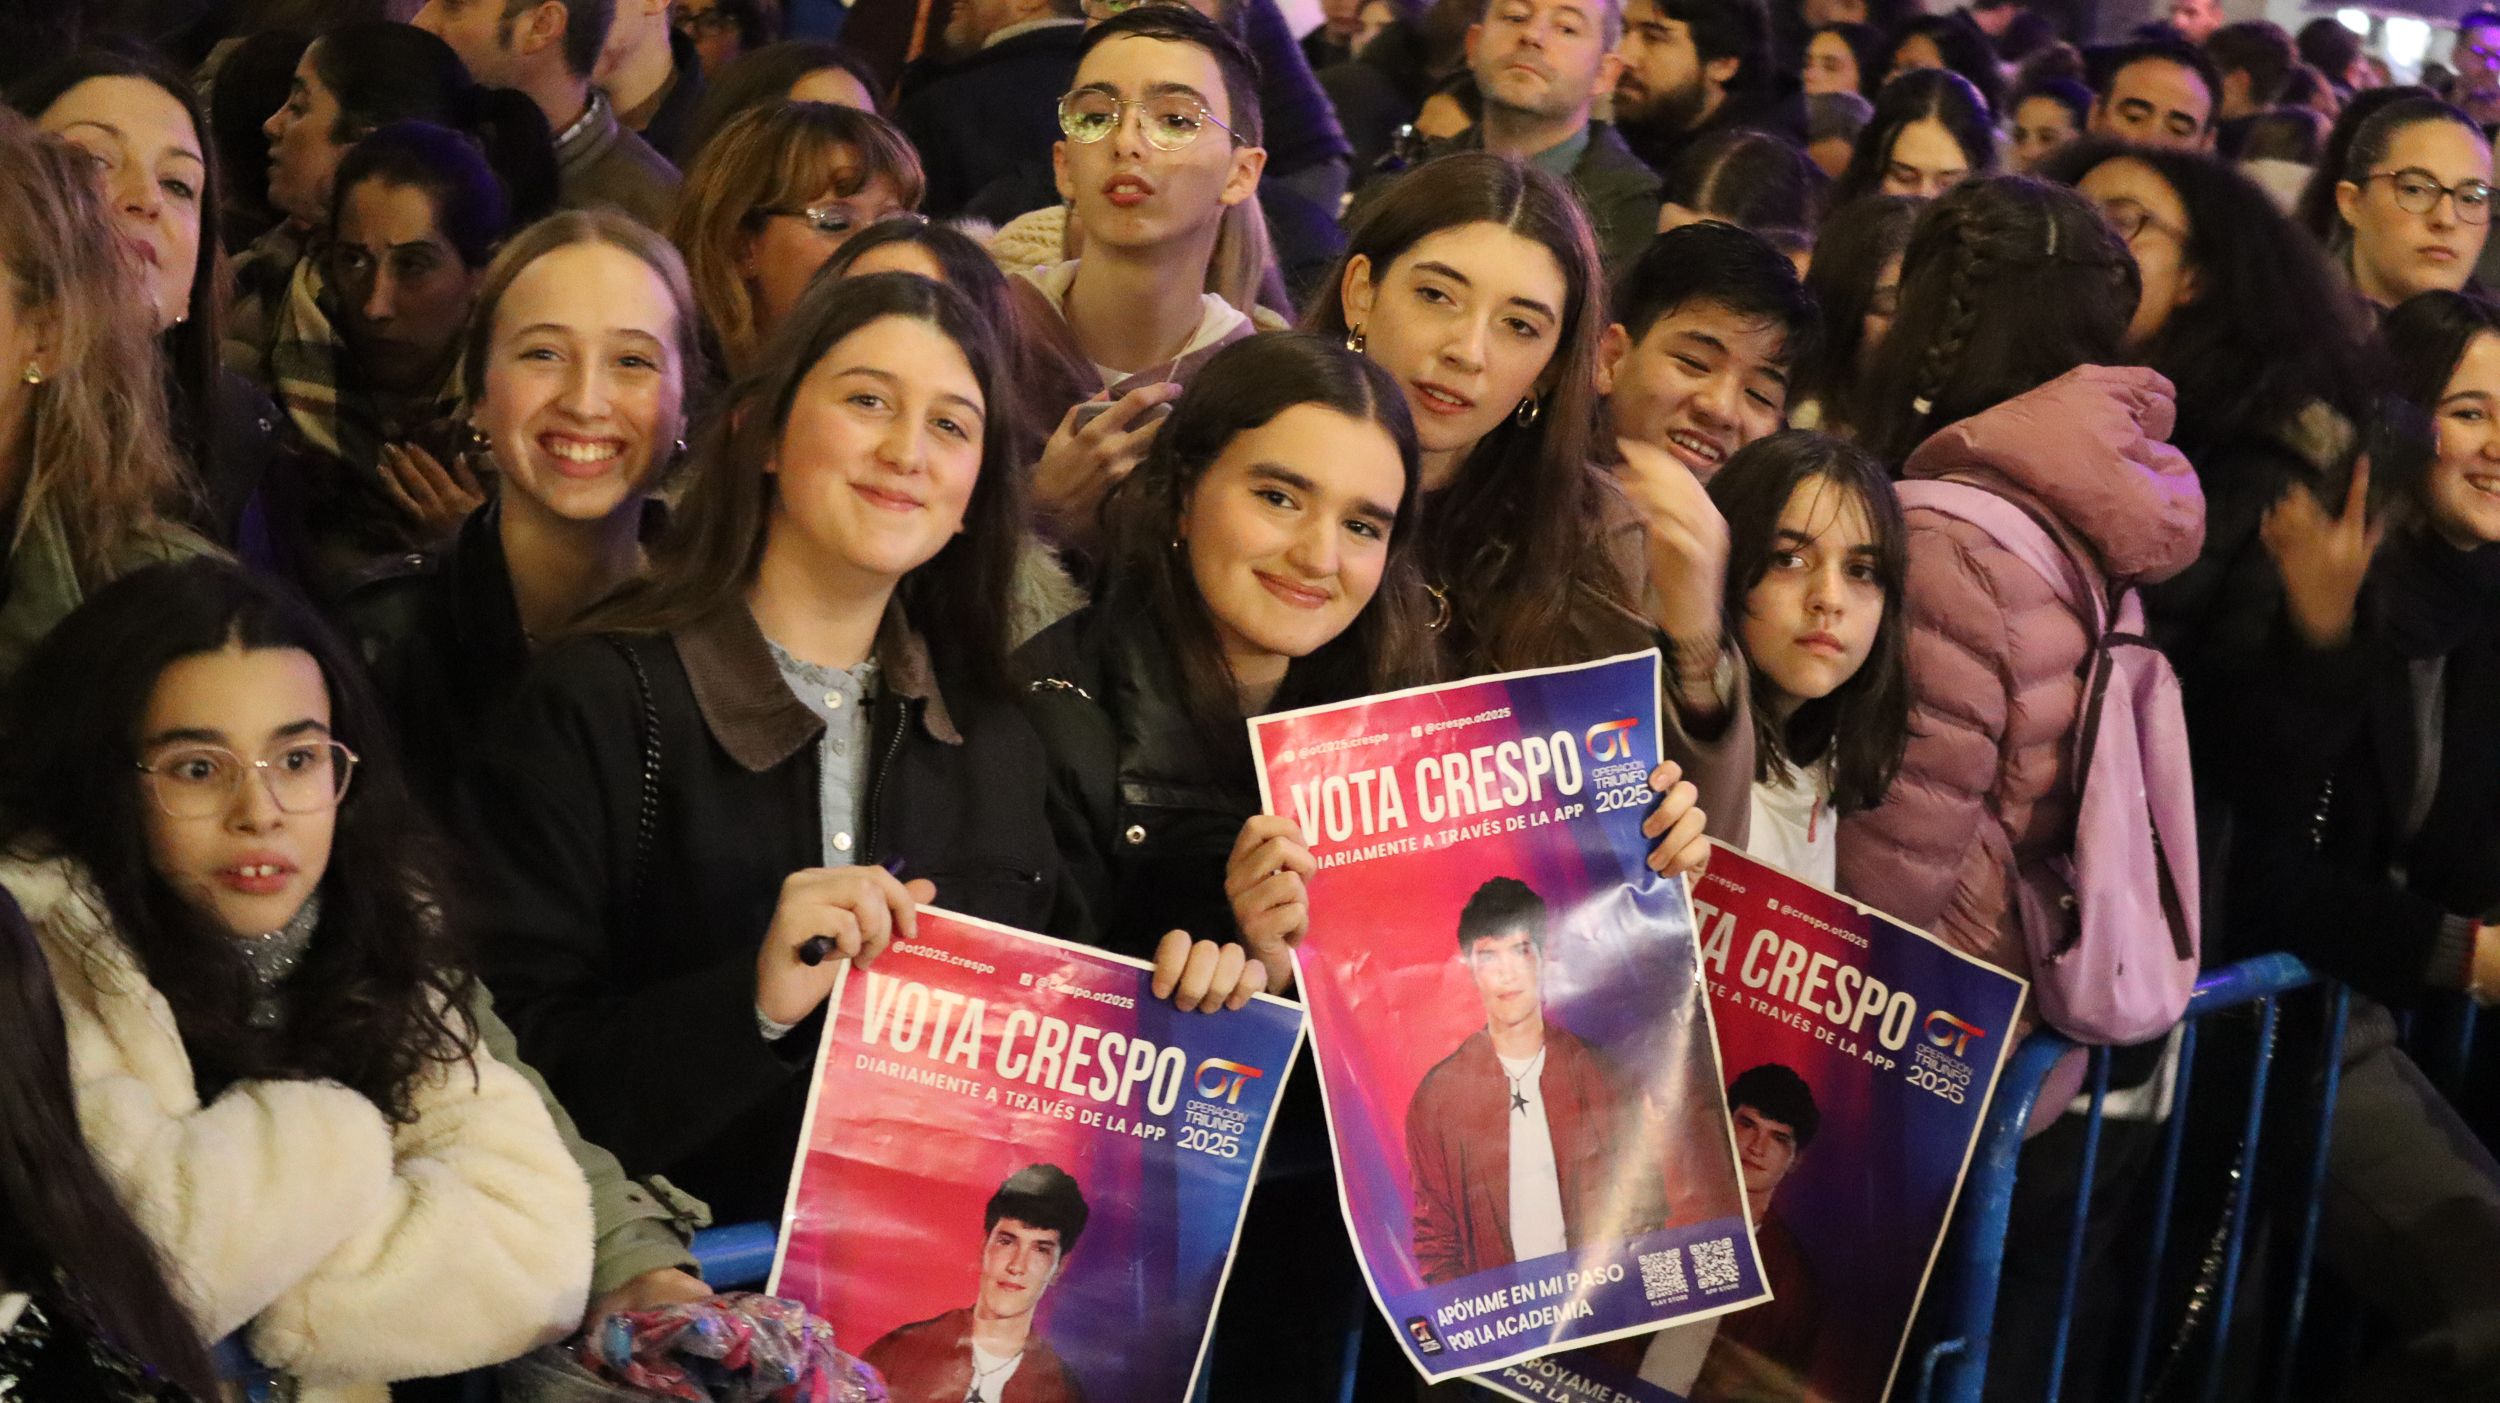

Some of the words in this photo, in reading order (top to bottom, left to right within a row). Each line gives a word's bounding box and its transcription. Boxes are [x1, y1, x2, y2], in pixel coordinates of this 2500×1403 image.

[1424, 707, 1512, 735] @crespo.ot2025
[1586, 718, 1639, 762] OT
[1298, 732, 1389, 759] @ot2025.crespo
[1290, 765, 1409, 848] VOTA
[1415, 730, 1584, 824] CRESPO
[1593, 769, 1648, 790] TRIUNFO
[1595, 783, 1653, 813] 2025
[1317, 837, 1418, 870] IARIAMENTE
[1423, 834, 1435, 848] A
[1438, 819, 1501, 845] TRAVÉS
[1506, 818, 1526, 832] DE
[1530, 811, 1550, 826] LA
[1554, 803, 1584, 822] APP
[1705, 873, 1746, 894] .crespo
[1780, 904, 1870, 949] @crespo.ot2025
[892, 941, 995, 975] @ot2025.crespo
[1694, 898, 1737, 975] TA
[1740, 929, 1917, 1052] CRESPO
[862, 971, 986, 1070] VOTA
[995, 1009, 1187, 1117] CRESPO
[1731, 991, 1742, 1004] A
[1750, 996, 1812, 1033] TRAVÉS
[1814, 1026, 1836, 1045] DE
[1839, 1038, 1857, 1056] LA
[1862, 1051, 1895, 1071] APP
[1924, 1010, 1987, 1057] OT
[1194, 1057, 1264, 1105] OT
[1905, 1065, 1965, 1104] 2025
[1915, 1051, 1971, 1086] TRIUNFO
[855, 1053, 982, 1098] DIARIAMENTE
[984, 1086, 998, 1101] A
[1006, 1091, 1075, 1121] TRAVÉS
[1079, 1109, 1103, 1127] DE
[1106, 1115, 1126, 1133] LA
[1131, 1122, 1166, 1141] APP
[1176, 1125, 1240, 1159] 2025
[1184, 1109, 1245, 1135] TRIUNFO
[1437, 1289, 1509, 1327] APÓYAME
[1511, 1282, 1536, 1305] EN
[1539, 1275, 1563, 1298] MI
[1566, 1263, 1625, 1292] PASO
[1447, 1329, 1478, 1351] POR
[1475, 1324, 1496, 1345] LA
[1496, 1299, 1594, 1339] ACADEMIA
[1503, 1367, 1545, 1393] POR
[1546, 1388, 1570, 1403] LA
